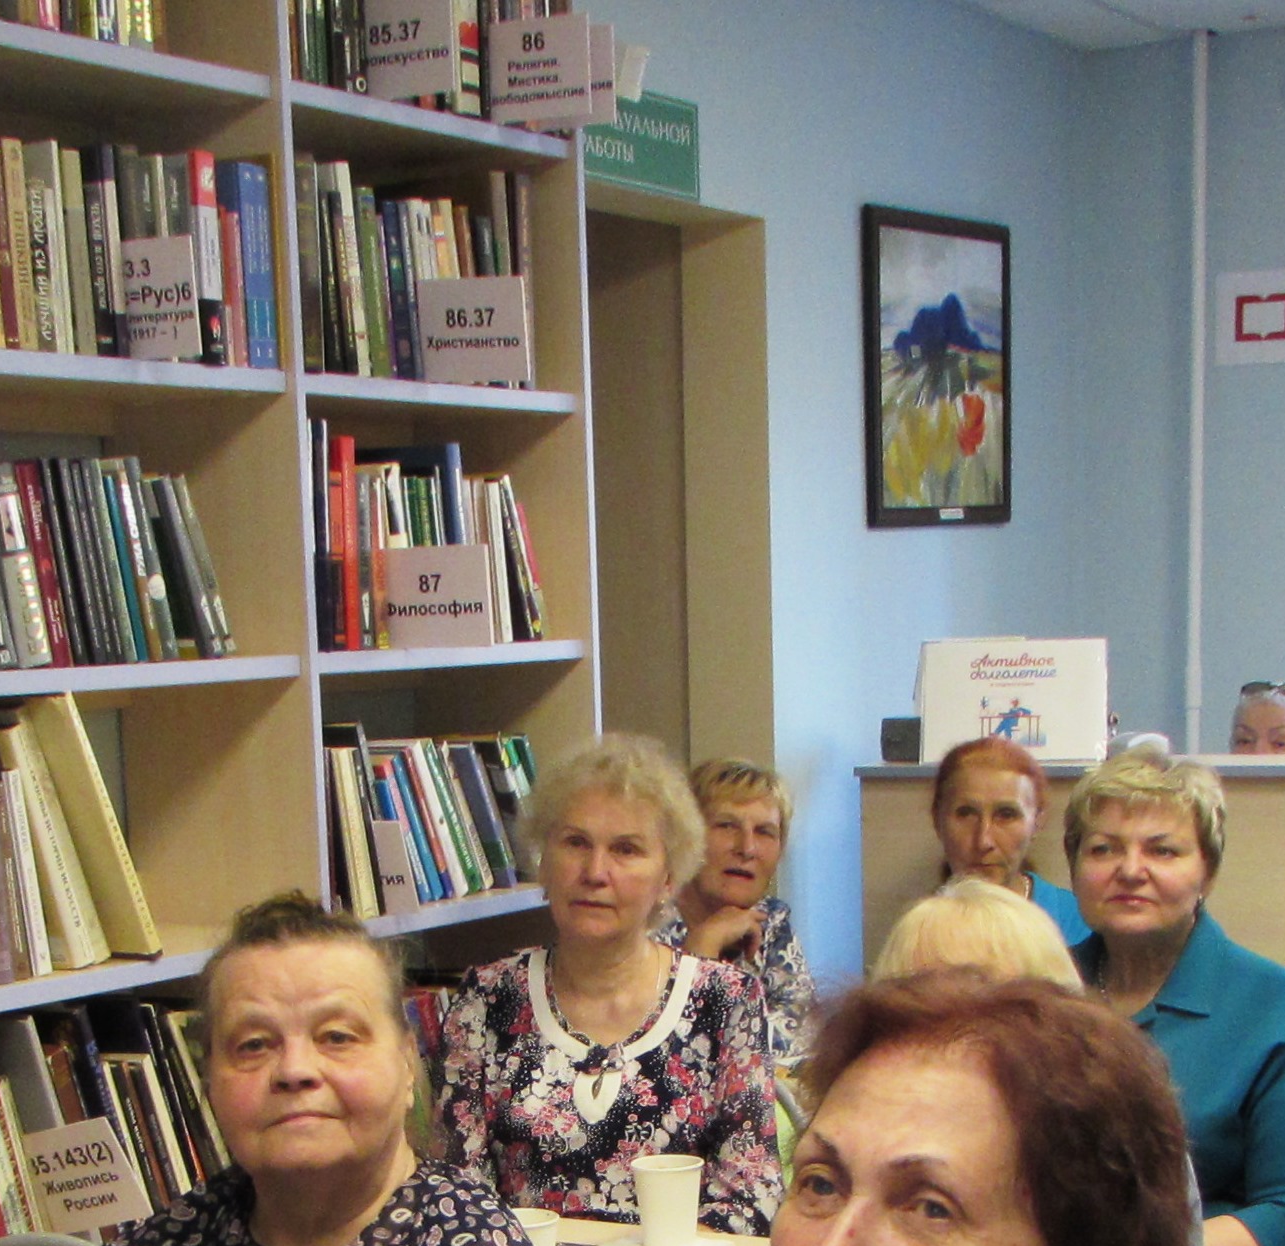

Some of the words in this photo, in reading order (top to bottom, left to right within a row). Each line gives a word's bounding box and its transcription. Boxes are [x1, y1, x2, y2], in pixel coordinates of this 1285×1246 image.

[369, 20, 421, 46] 85.37
[522, 32, 545, 52] 86
[508, 74, 561, 87] Мистика.
[125, 282, 192, 305] =Рус)6
[445, 308, 495, 329] 86.37
[426, 336, 520, 352] Христианство
[419, 574, 441, 593] 87
[970, 652, 1055, 671] Активное
[969, 668, 1057, 681] долголетие
[45, 1172, 119, 1197] Живопись
[63, 1192, 119, 1213] России
